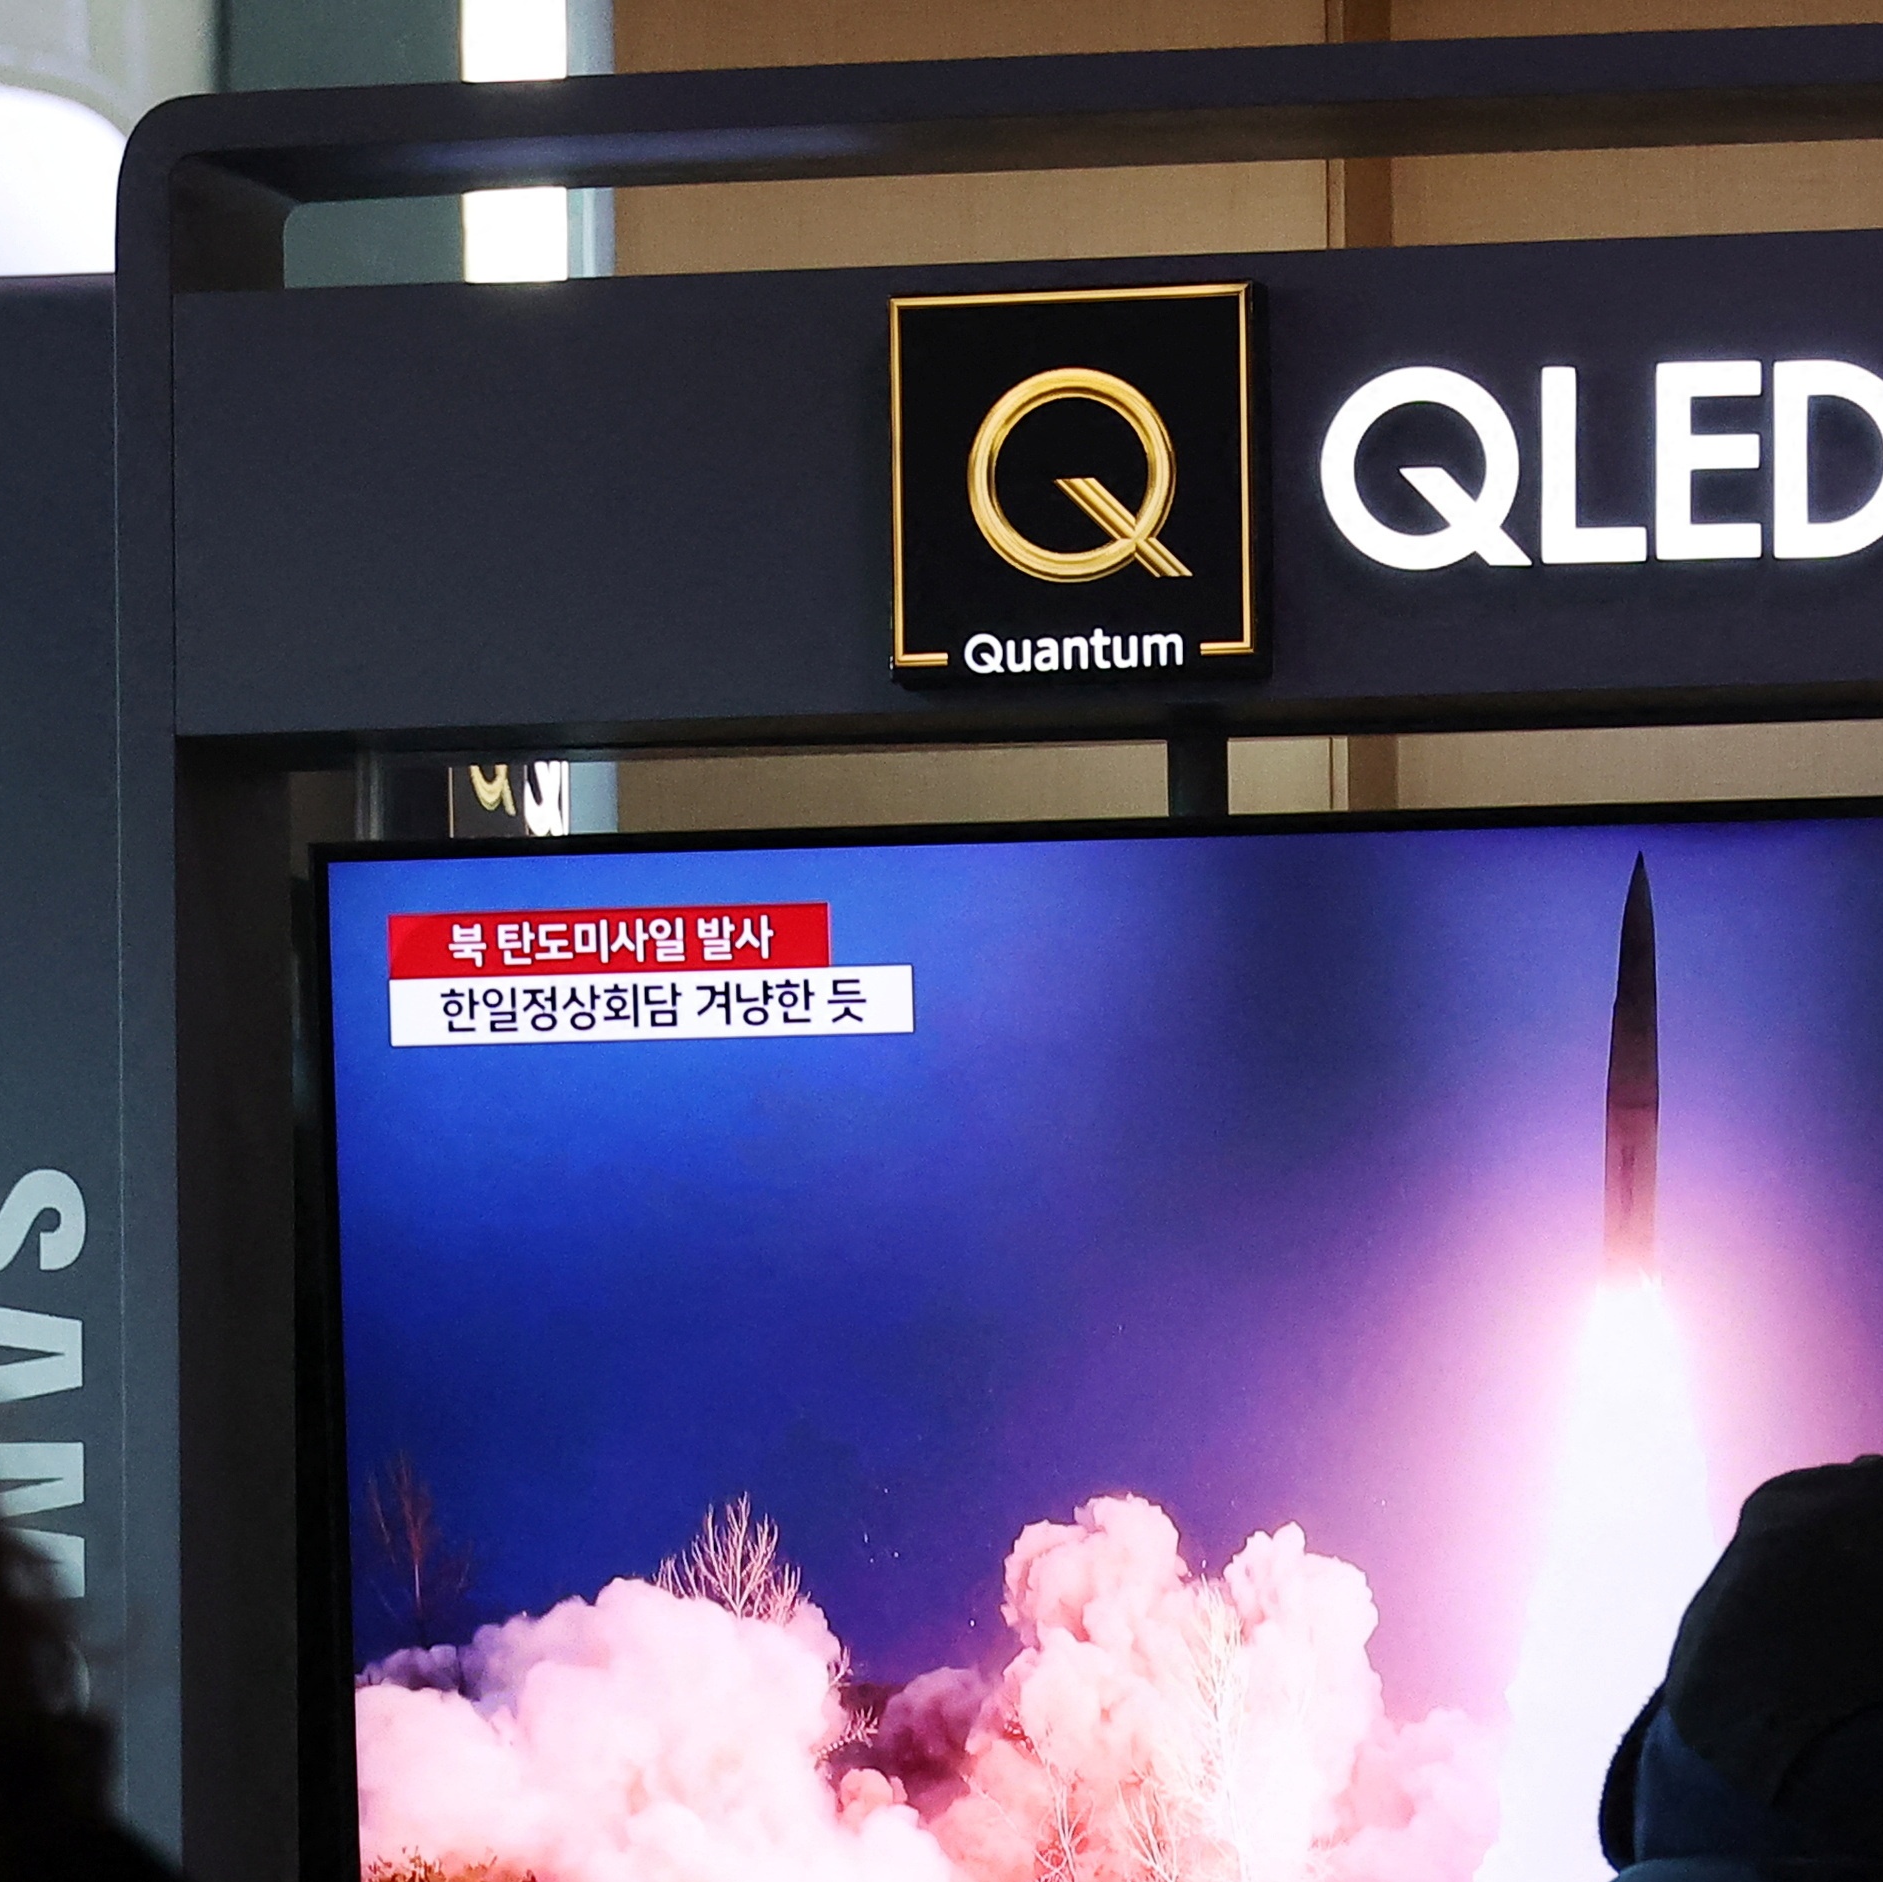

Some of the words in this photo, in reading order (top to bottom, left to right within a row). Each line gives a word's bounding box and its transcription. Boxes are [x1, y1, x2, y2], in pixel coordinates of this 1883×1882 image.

[968, 367, 1193, 581] Q
[963, 627, 1184, 675] Quantum
[447, 922, 487, 967] 북
[497, 915, 685, 967] 탄도미사일
[696, 913, 774, 961] 발사
[439, 982, 682, 1034] 한일정상회담
[696, 978, 816, 1028] 겨냥한
[826, 978, 868, 1024] 듯
